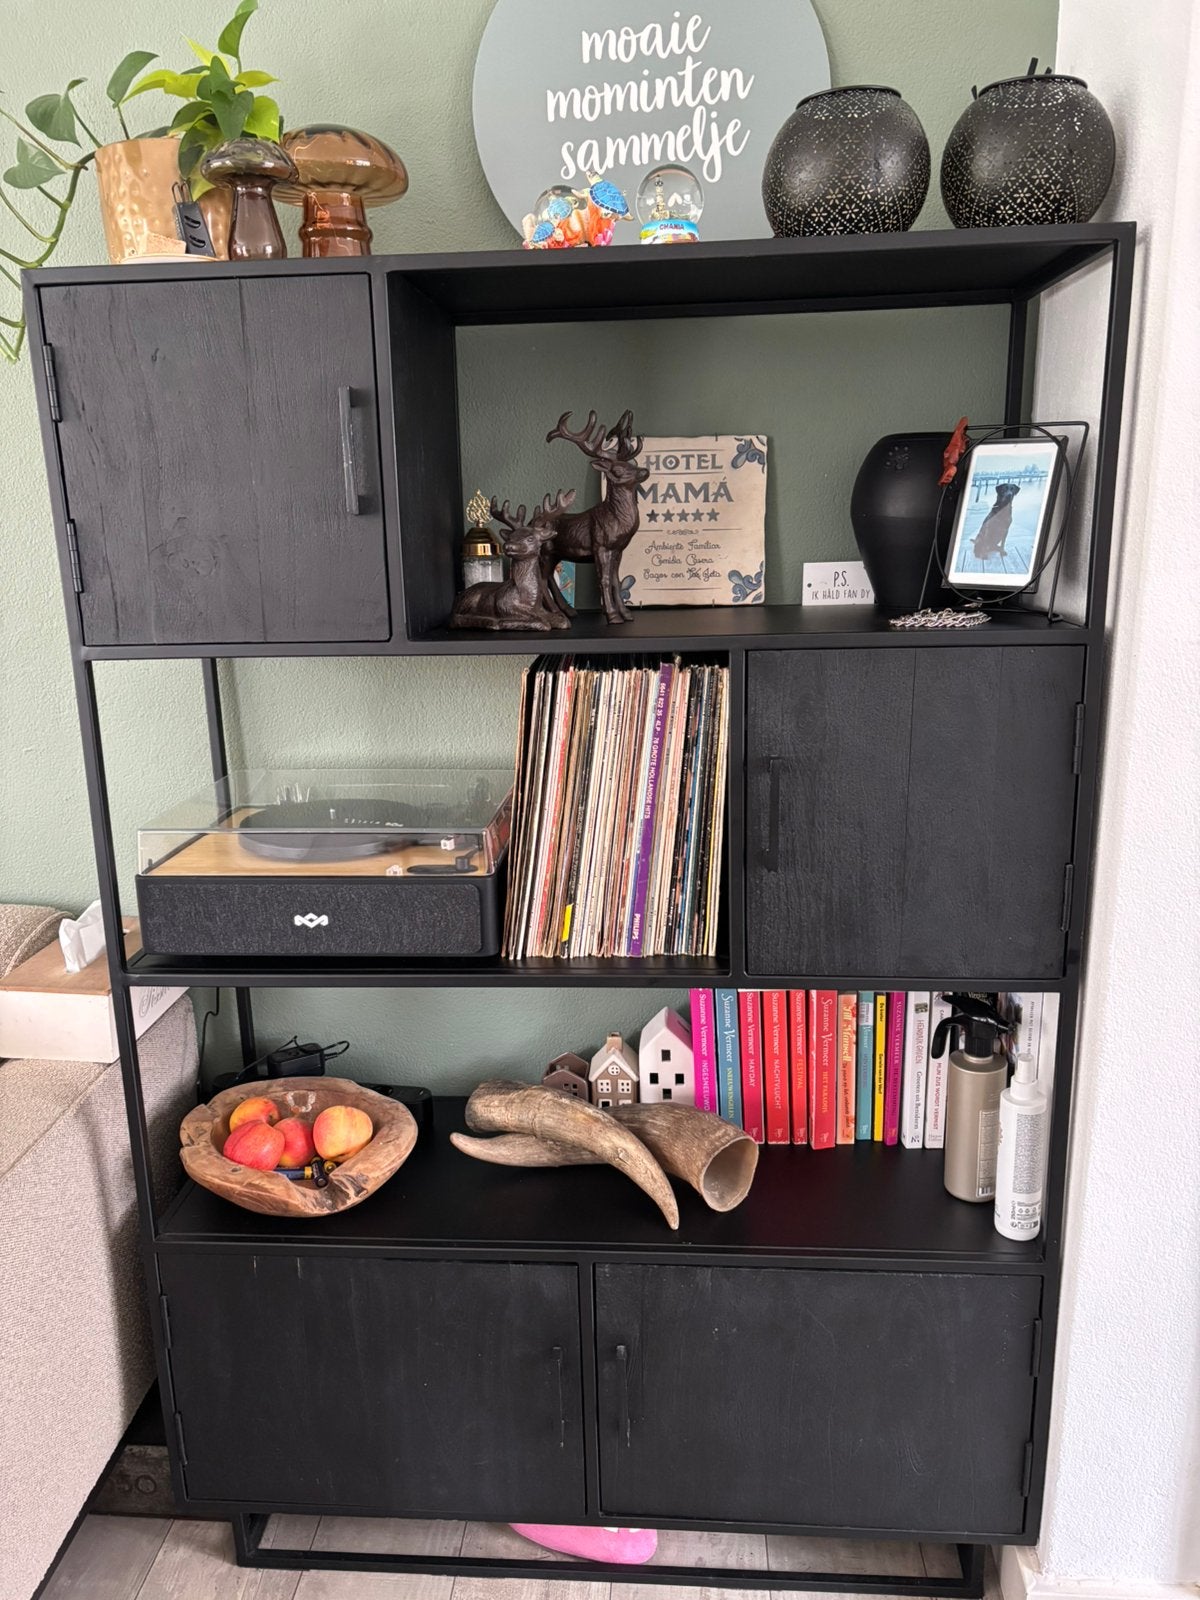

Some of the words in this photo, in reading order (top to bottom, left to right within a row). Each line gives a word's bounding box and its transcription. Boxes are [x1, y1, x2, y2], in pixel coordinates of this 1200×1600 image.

[581, 11, 711, 64] moaie
[546, 55, 754, 122] mominten
[560, 105, 750, 183] sammelje
[644, 454, 723, 470] HOTEL
[637, 477, 734, 504] MAMÁ
[645, 540, 684, 554] Ambiente
[812, 591, 819, 600] IK
[844, 589, 857, 598] FAN
[861, 589, 870, 598] DY
[834, 571, 849, 587] P.S.
[650, 745, 659, 766] GROTE
[646, 767, 657, 804] HOLLANDSE
[645, 805, 653, 819] HITS
[632, 914, 641, 940] PHILIPS
[699, 994, 707, 1024] Suzanne
[721, 993, 734, 1028] Suzanne
[821, 997, 833, 1031] Suzanne
[723, 1029, 735, 1062] Vermeer
[747, 1024, 755, 1055] Vermeer
[796, 1024, 804, 1055] Vermeer
[821, 1033, 833, 1066] Vermeer
[842, 1024, 851, 1062] Mansell
